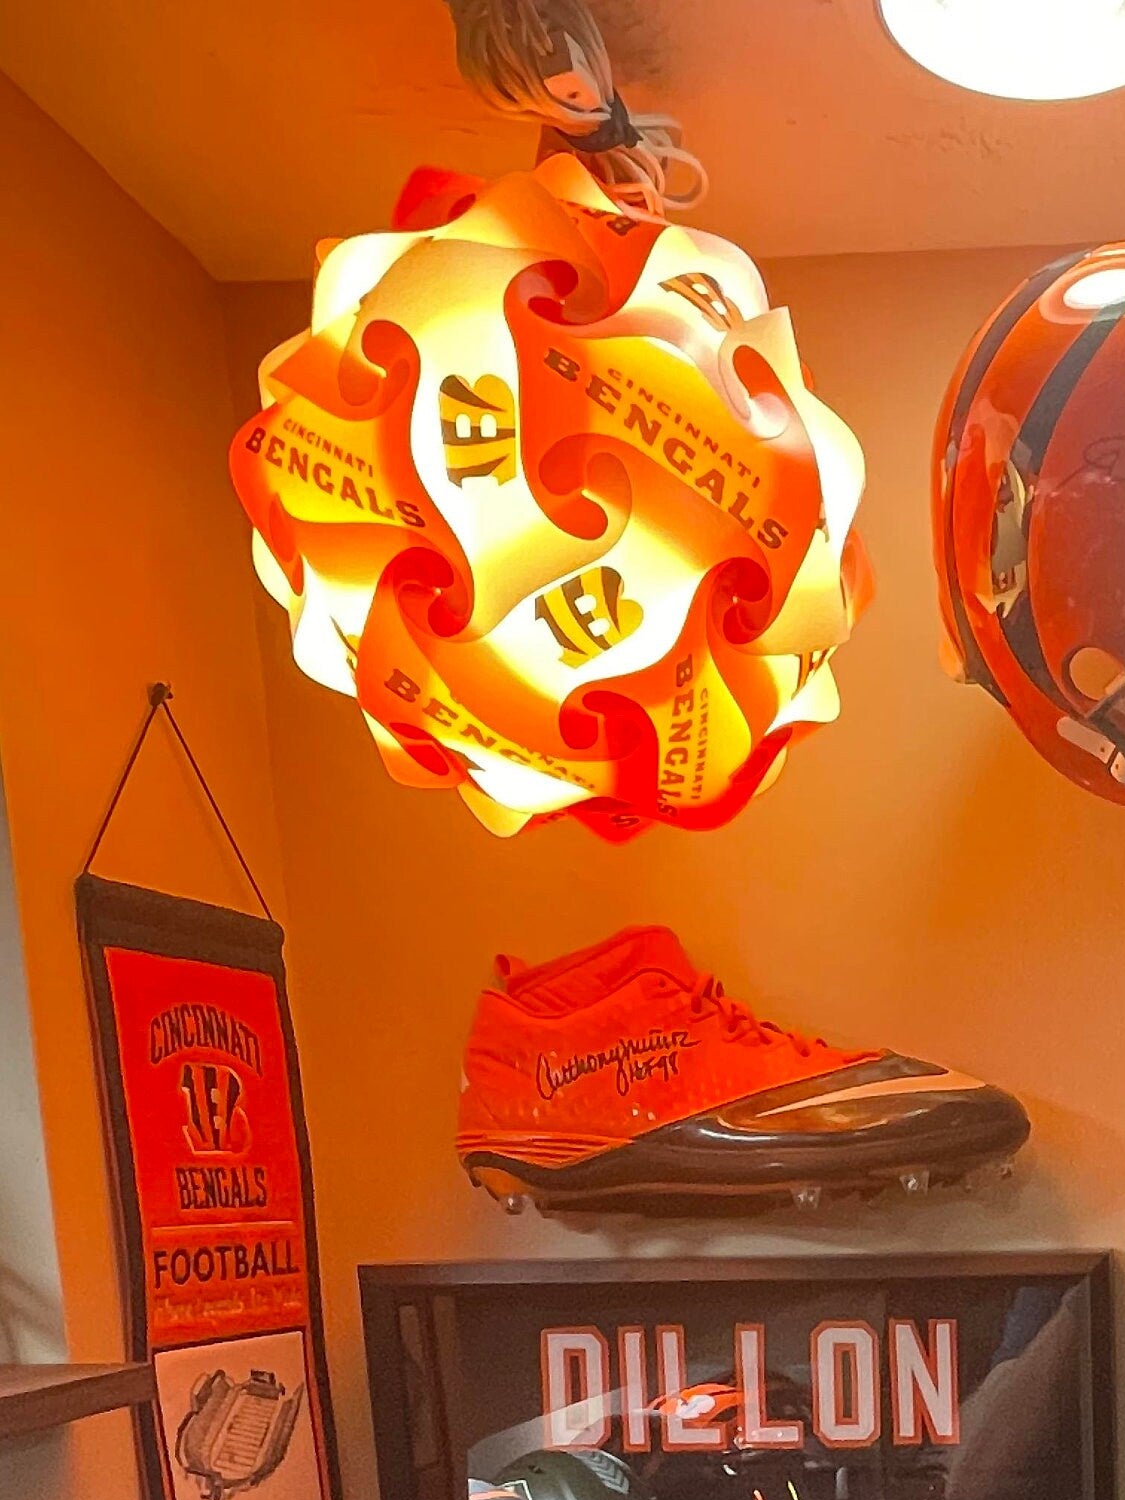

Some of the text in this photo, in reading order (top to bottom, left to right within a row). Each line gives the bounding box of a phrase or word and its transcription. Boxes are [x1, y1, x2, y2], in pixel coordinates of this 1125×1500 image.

[245, 427, 427, 528] BENGALS
[283, 418, 374, 478] CINCINNATI
[543, 347, 789, 550] BENGALS
[608, 368, 761, 489] CINCINNATI
[656, 653, 695, 818] BENGALS
[690, 687, 709, 800] CINCINNATI
[150, 1003, 263, 1079] CINCINNATI
[175, 1167, 268, 1210] BENGALS
[153, 1240, 301, 1290] FOOTBALL
[540, 1319, 961, 1452] DILLON
